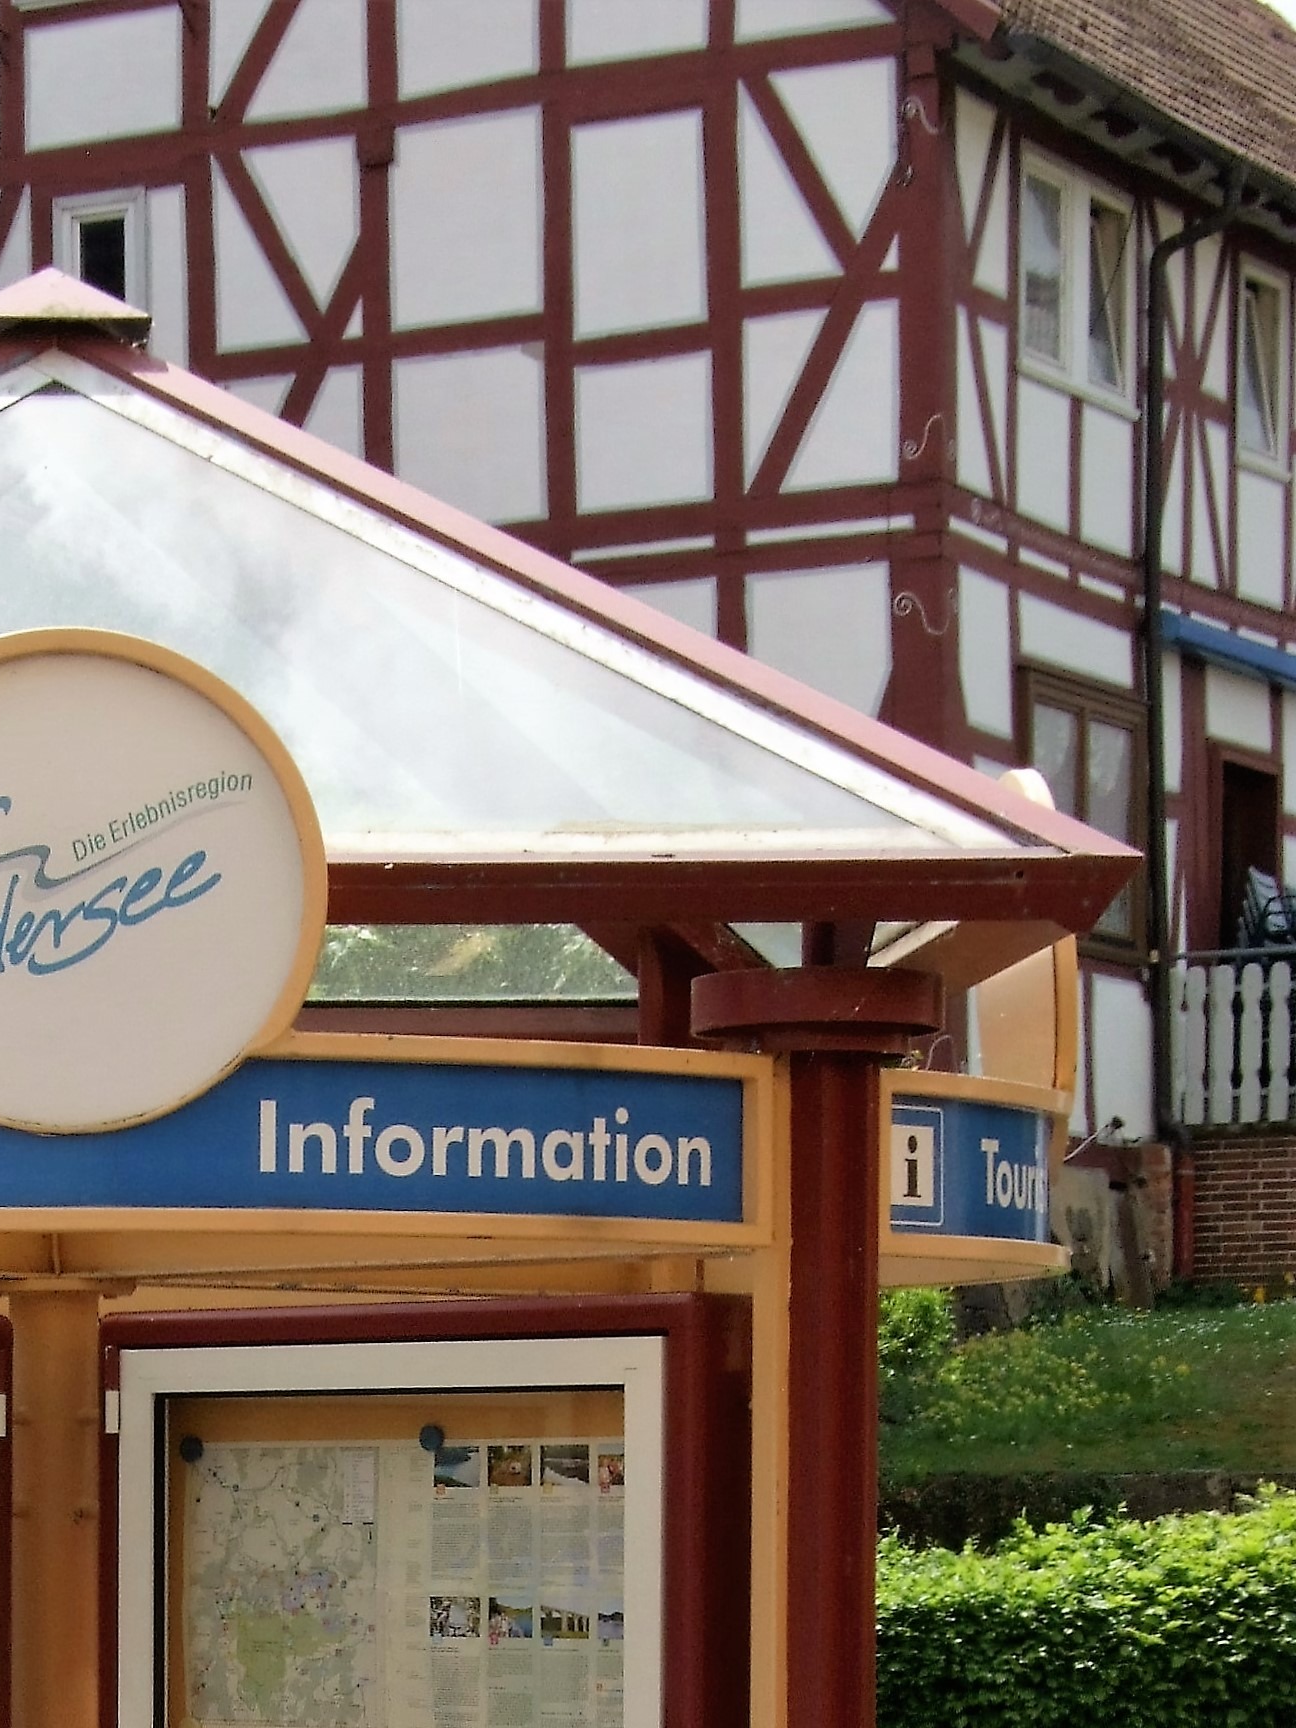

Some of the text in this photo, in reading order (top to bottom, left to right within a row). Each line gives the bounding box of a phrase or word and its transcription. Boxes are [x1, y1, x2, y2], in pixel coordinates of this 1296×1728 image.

[72, 772, 253, 862] Die Erlebnisregion
[258, 1096, 713, 1187] Information
